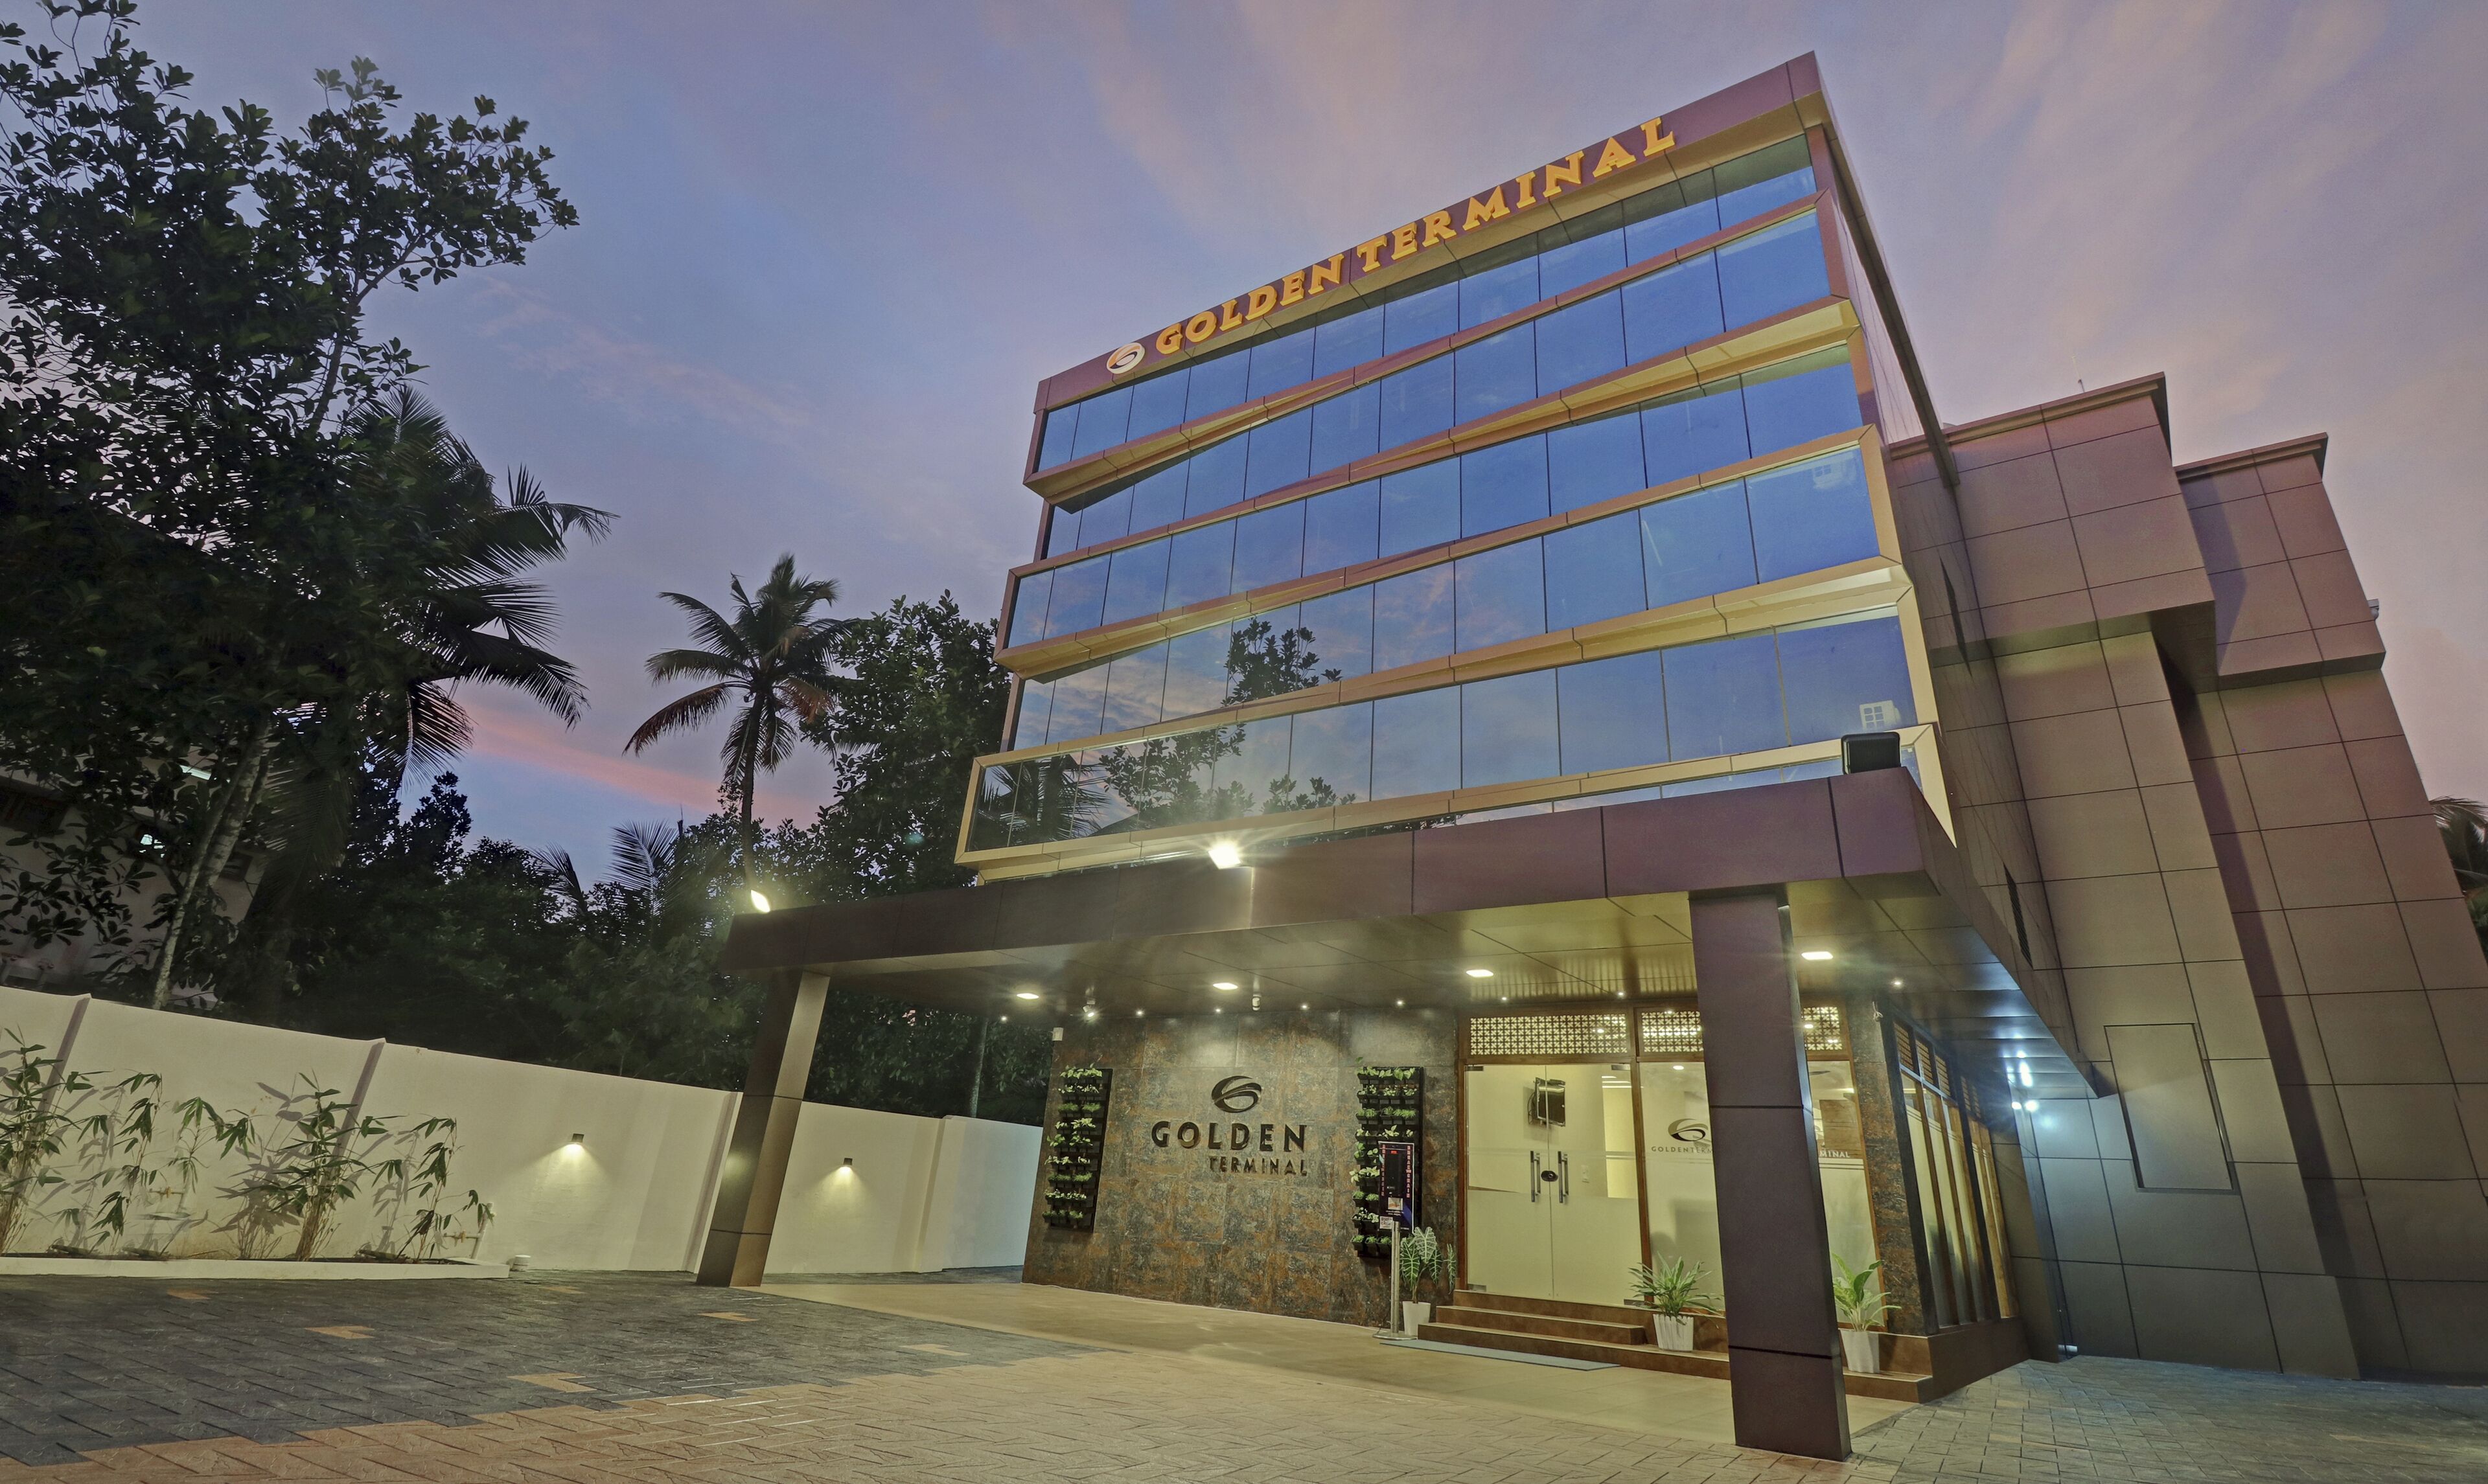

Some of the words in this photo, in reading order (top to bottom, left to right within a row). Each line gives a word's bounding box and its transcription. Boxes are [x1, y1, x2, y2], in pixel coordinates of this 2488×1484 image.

[1155, 253, 1344, 354] GOLDEN
[1357, 116, 1675, 273] TERMINAL
[1151, 1121, 1307, 1153] GOLDEN
[1209, 1156, 1307, 1176] TERMINAL
